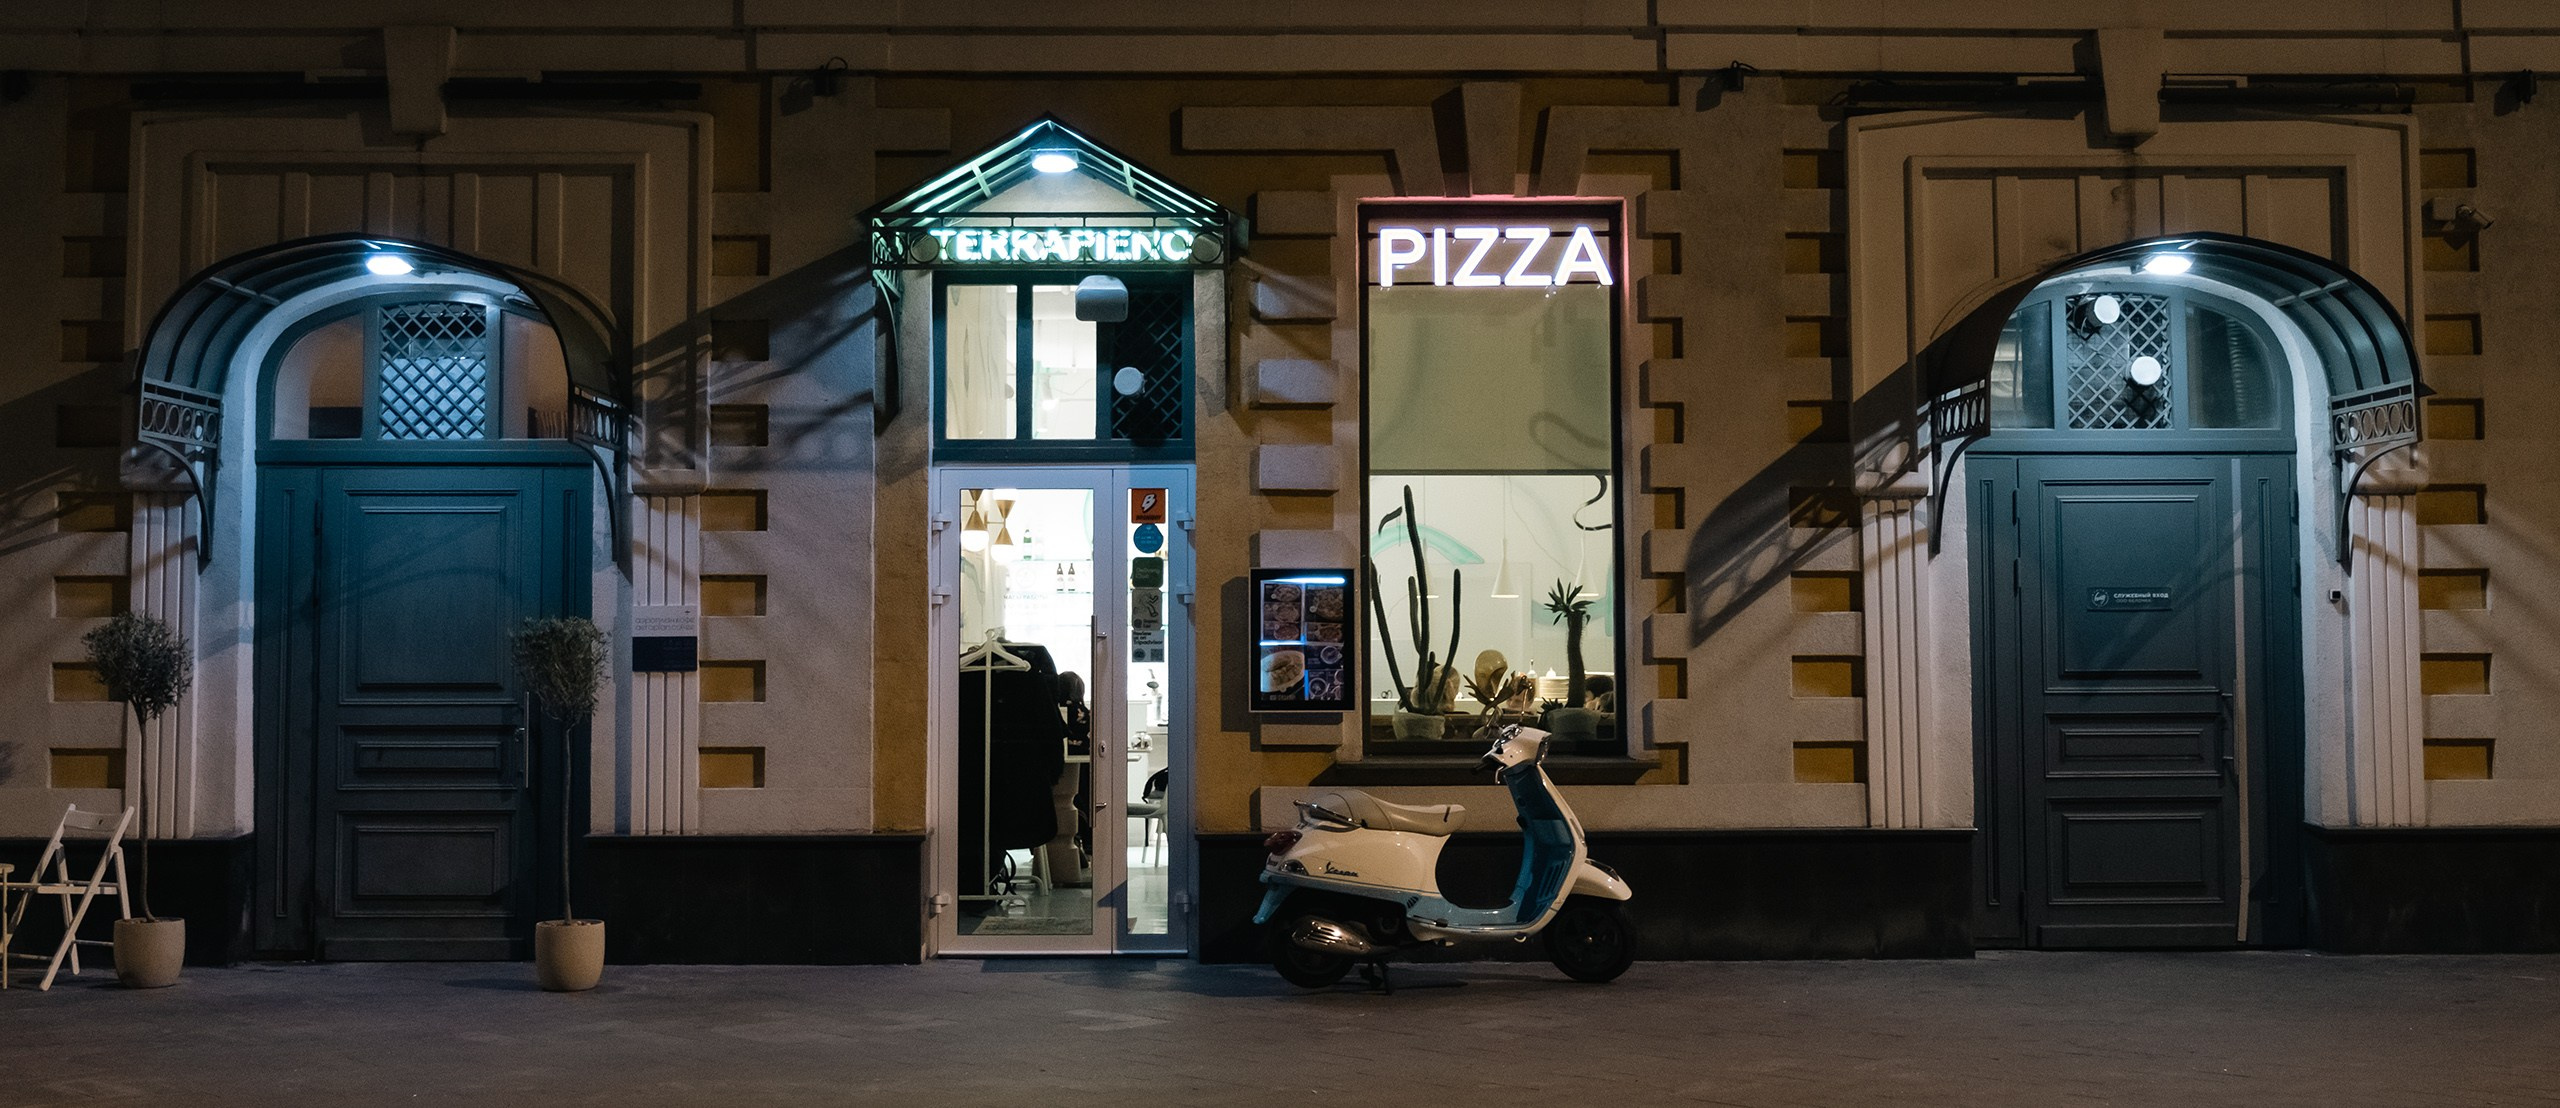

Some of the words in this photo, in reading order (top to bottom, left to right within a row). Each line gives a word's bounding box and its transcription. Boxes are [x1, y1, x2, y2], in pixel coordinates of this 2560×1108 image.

[928, 228, 1194, 261] TERRAPIENO
[1379, 225, 1613, 287] PIZZA
[2113, 591, 2151, 599] СЛУЖЕБНЫЙ
[1324, 861, 1359, 877] Vespa
